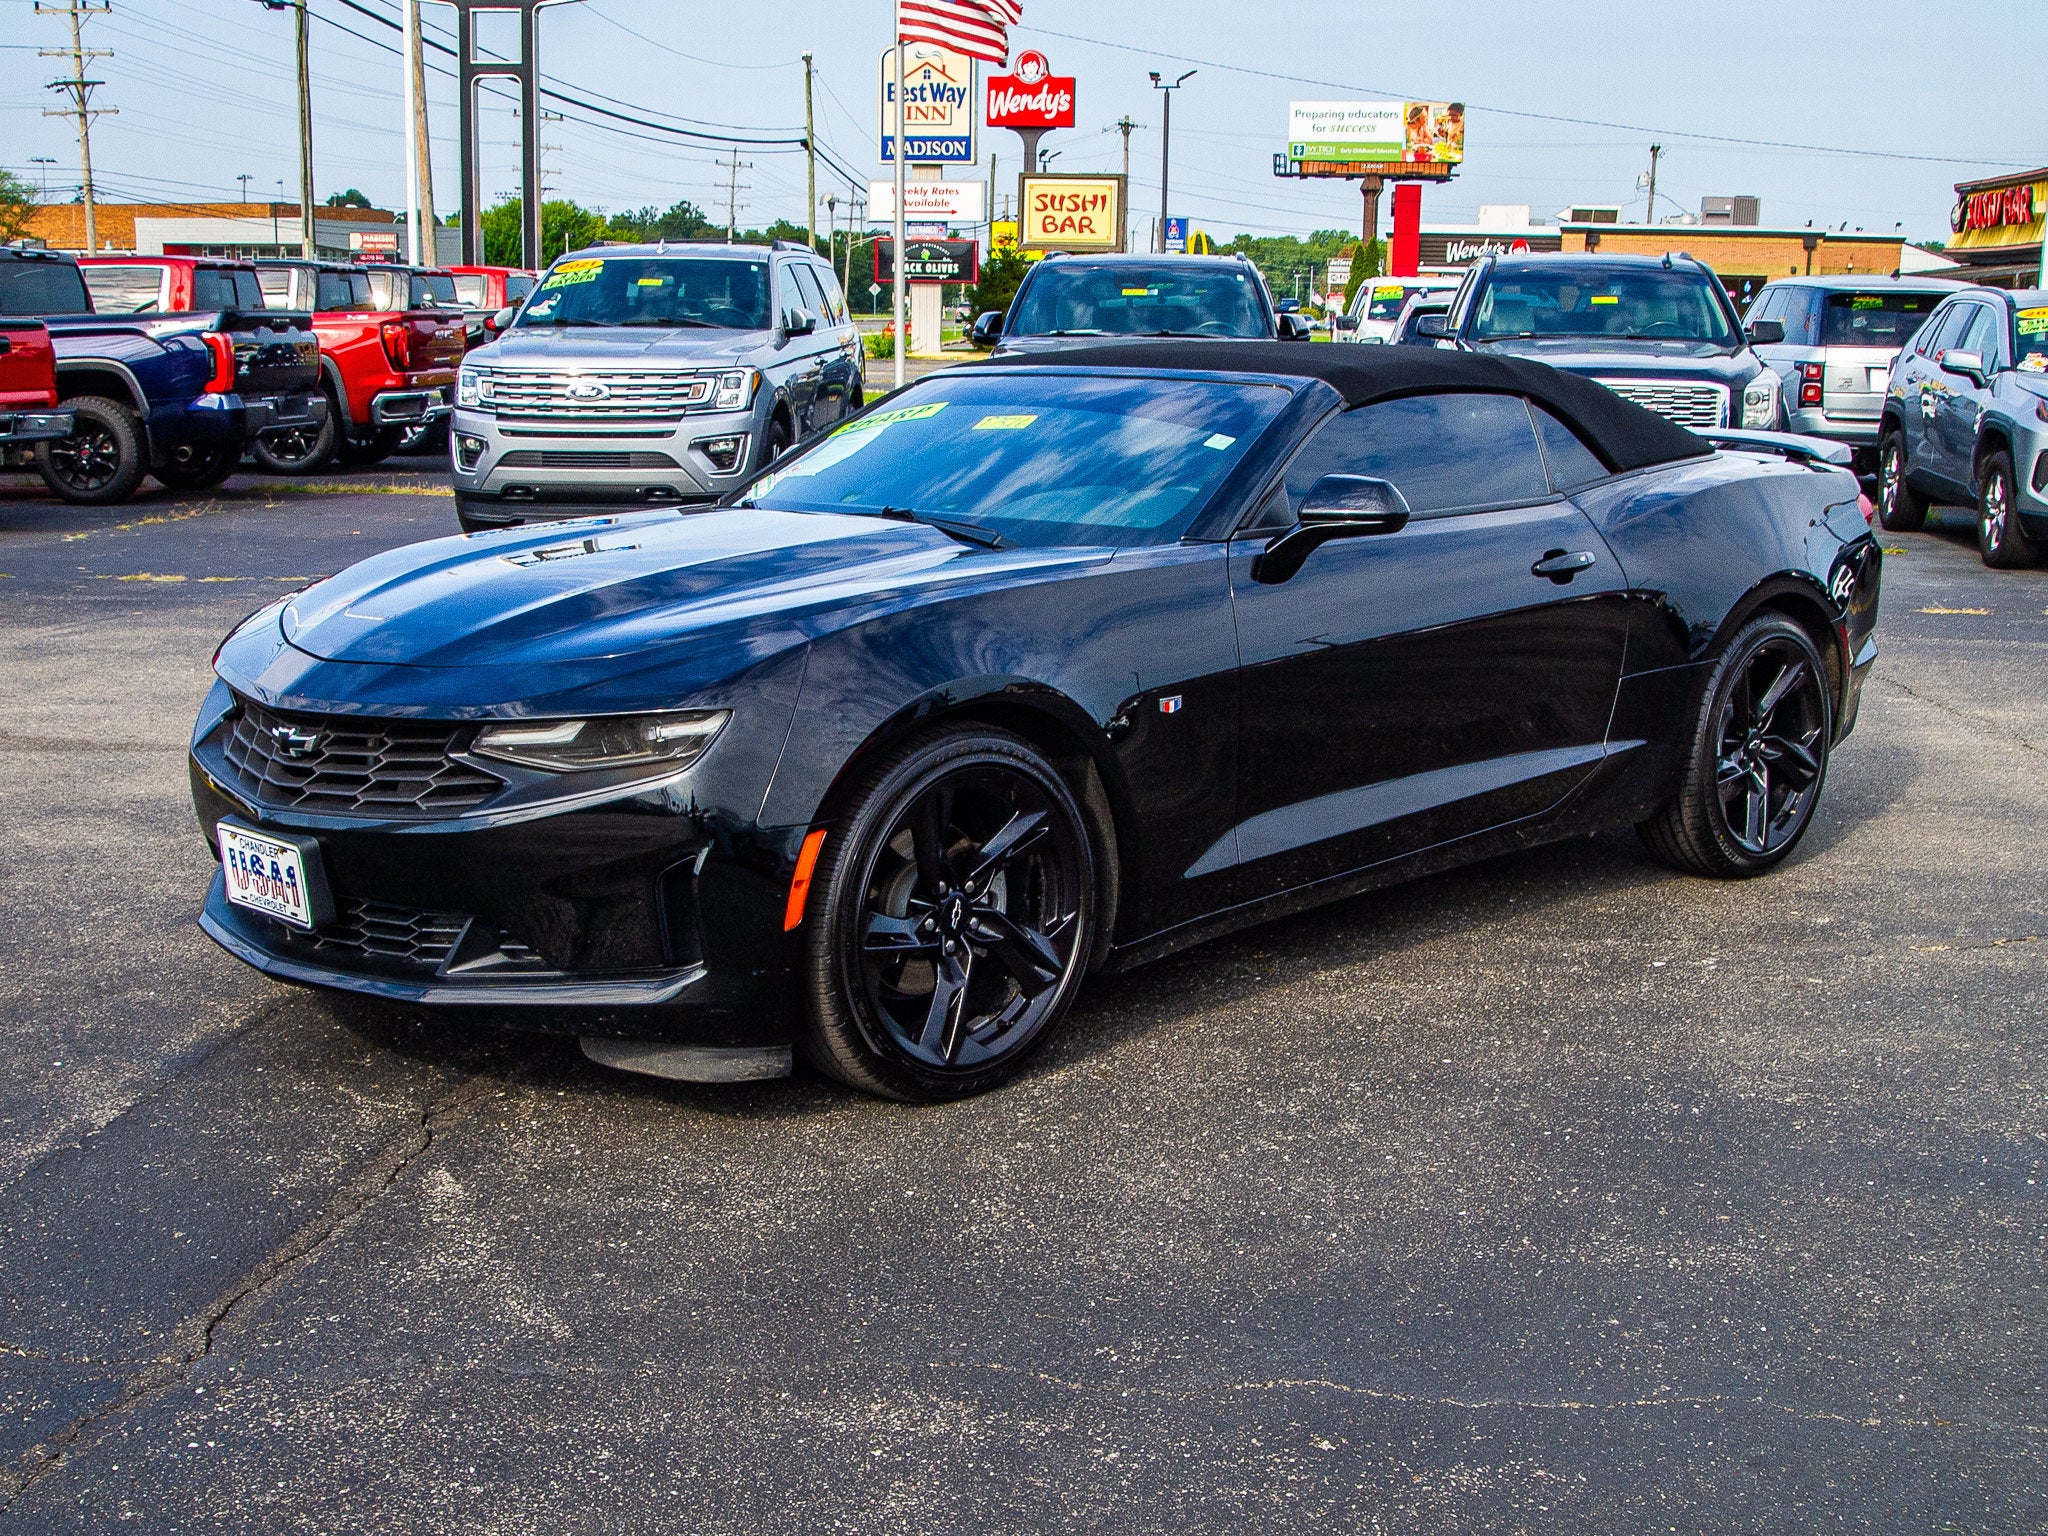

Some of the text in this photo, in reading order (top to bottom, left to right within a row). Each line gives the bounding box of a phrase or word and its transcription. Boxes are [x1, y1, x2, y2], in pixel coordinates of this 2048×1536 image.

[887, 82, 967, 109] Best Way
[989, 83, 1071, 120] Wendy's
[906, 106, 947, 120] INN
[1295, 109, 1399, 120] Preparing educators
[1312, 123, 1377, 133] for success
[932, 186, 959, 195] Rates
[903, 198, 950, 208] Available
[1034, 193, 1107, 213] SUSHI
[1042, 215, 1096, 234] BAR
[892, 262, 959, 273] ACK OLIVES
[239, 837, 279, 860] CHANDLER
[249, 893, 288, 914] CHEVROLET
